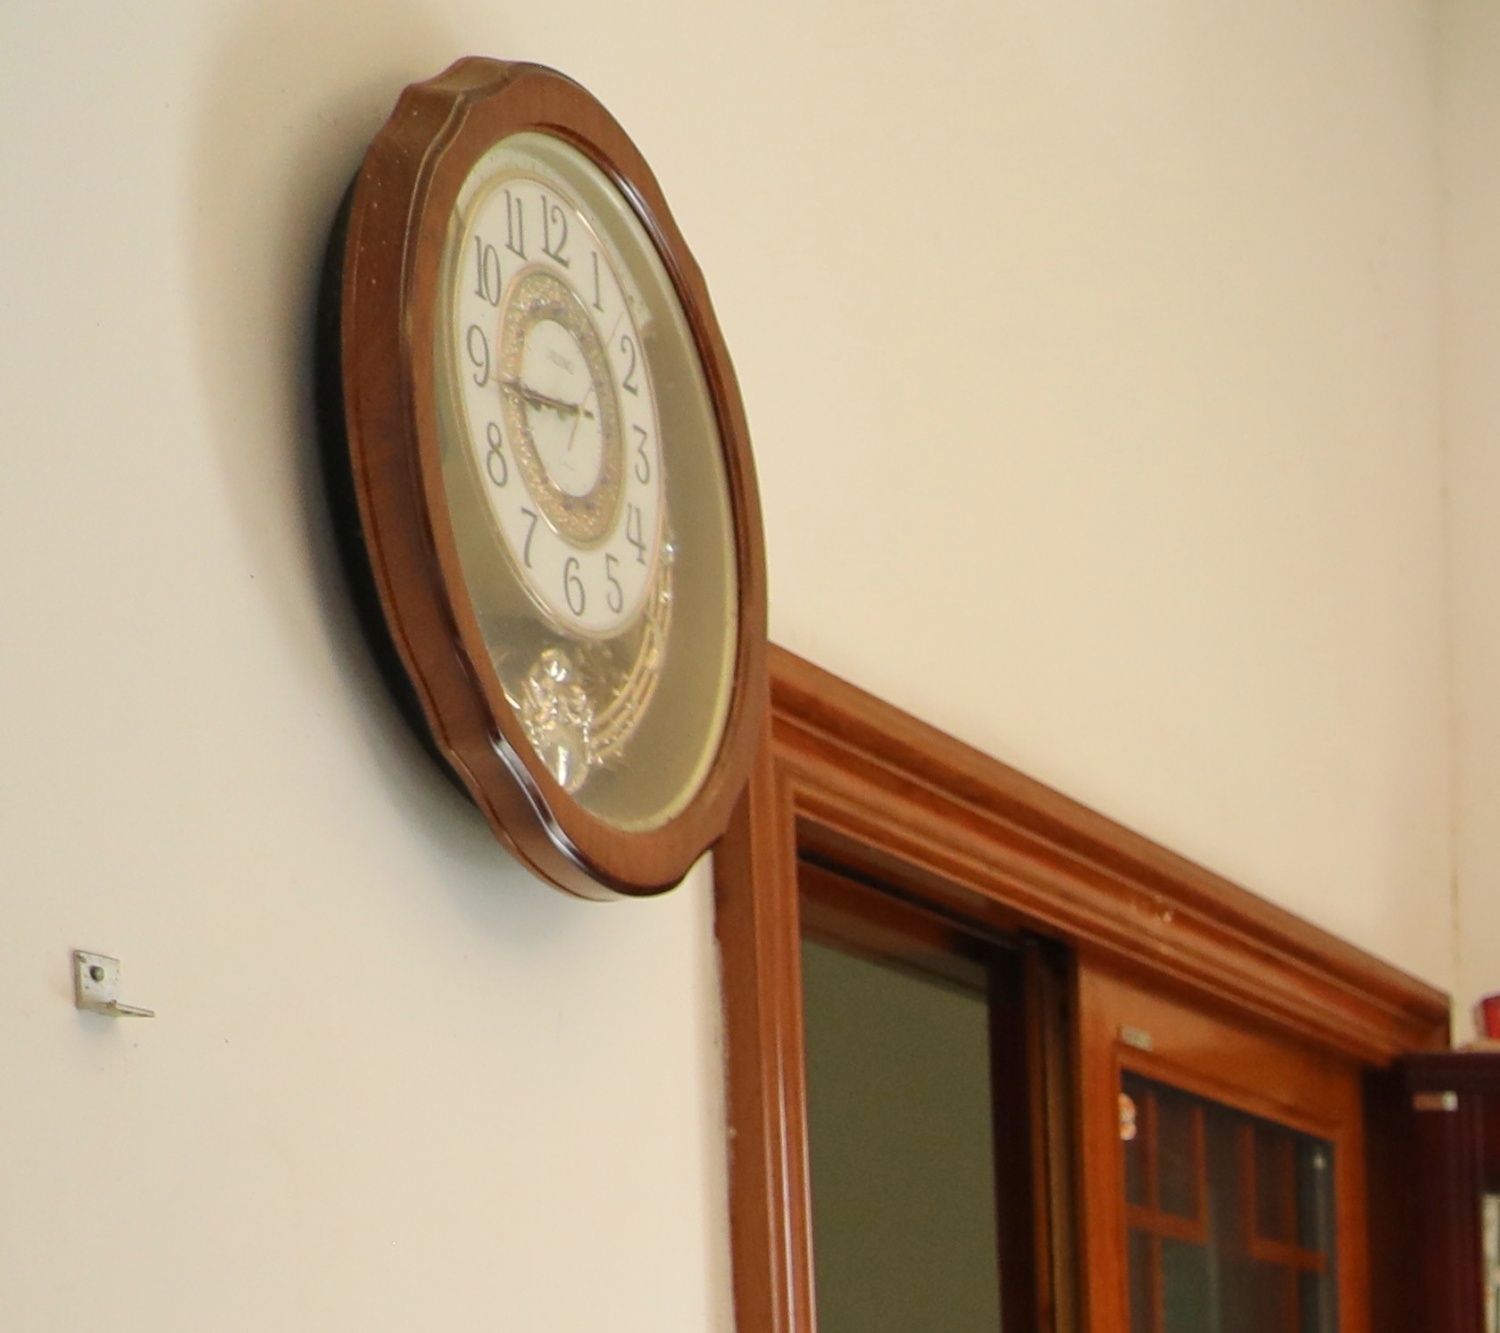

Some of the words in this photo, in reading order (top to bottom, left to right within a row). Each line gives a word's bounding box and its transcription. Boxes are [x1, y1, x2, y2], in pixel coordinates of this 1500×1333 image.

[506, 189, 528, 261] 11
[541, 195, 569, 268] 12
[474, 235, 501, 308] 10
[592, 251, 604, 313] 1
[467, 324, 490, 388] 9
[620, 334, 639, 396] 2
[486, 422, 508, 487] 8
[633, 424, 650, 485] 3
[521, 506, 538, 569] 7
[626, 502, 646, 565] 4
[564, 557, 585, 616] 6
[605, 553, 623, 613] 5
